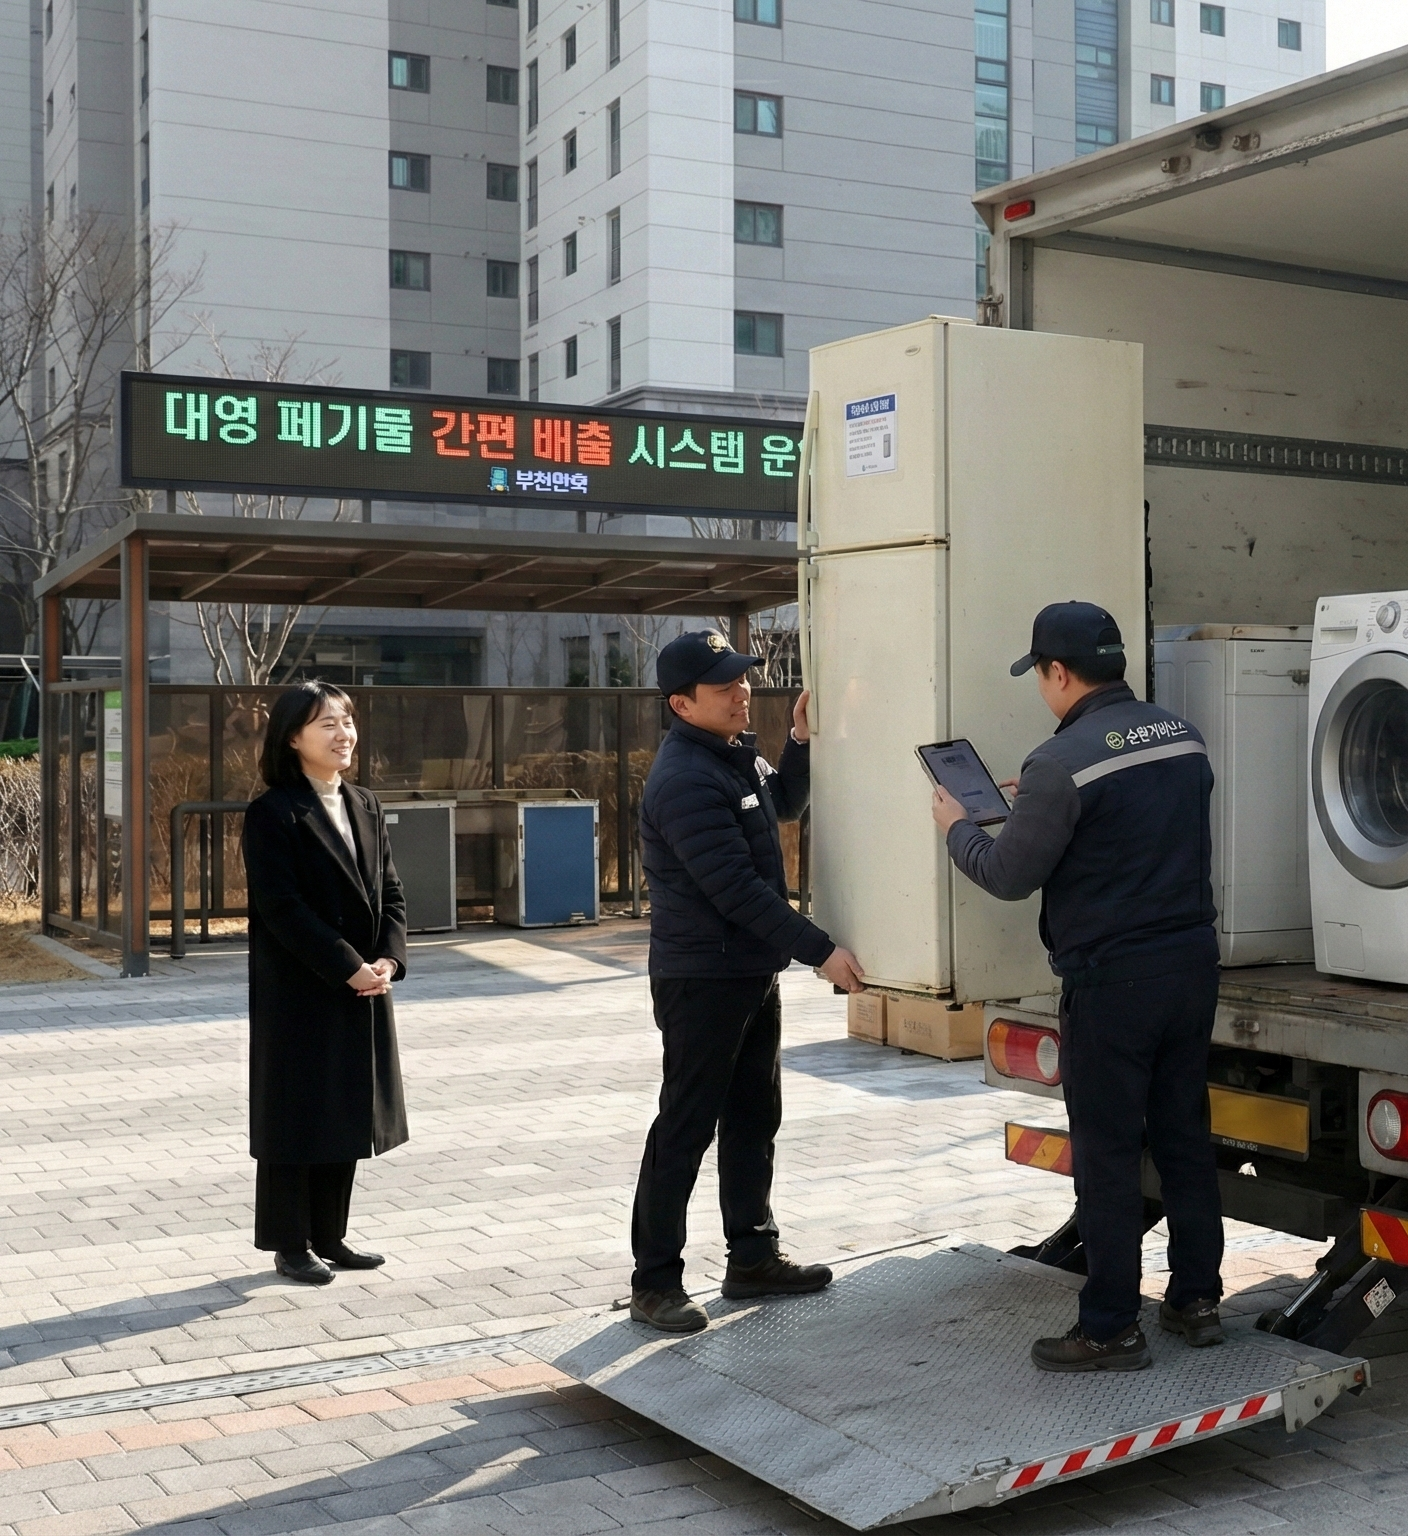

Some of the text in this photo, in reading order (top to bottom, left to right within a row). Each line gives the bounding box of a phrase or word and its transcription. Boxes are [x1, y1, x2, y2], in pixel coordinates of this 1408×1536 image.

[163, 389, 258, 446] 대영
[275, 398, 413, 455] 폐기물
[431, 408, 516, 461] 간편
[532, 417, 613, 467] 배출
[626, 424, 746, 475] 시스템
[759, 434, 804, 478] 운
